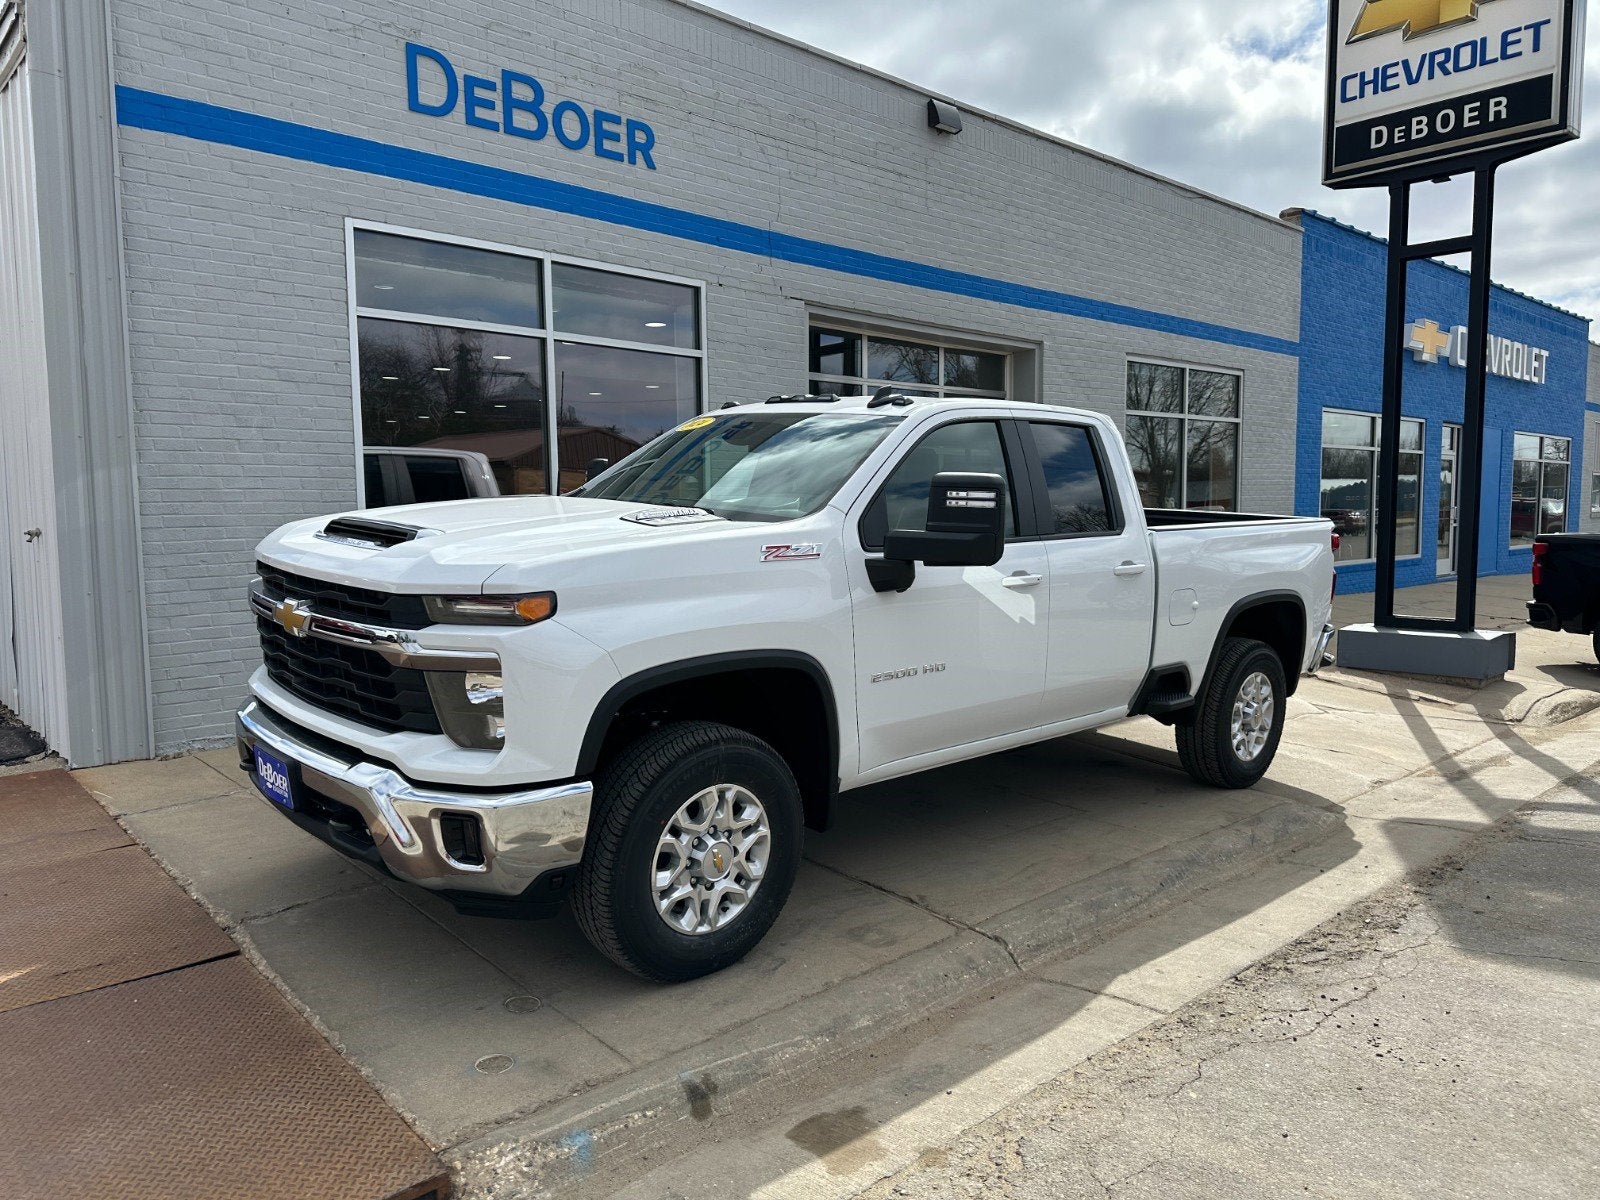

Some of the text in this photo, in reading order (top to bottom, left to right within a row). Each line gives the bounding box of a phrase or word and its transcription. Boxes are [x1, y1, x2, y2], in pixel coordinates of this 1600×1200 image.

[1340, 18, 1550, 104] CHEVROLET
[1451, 325, 1549, 384] CVROLET
[870, 661, 946, 683] 2500 HD
